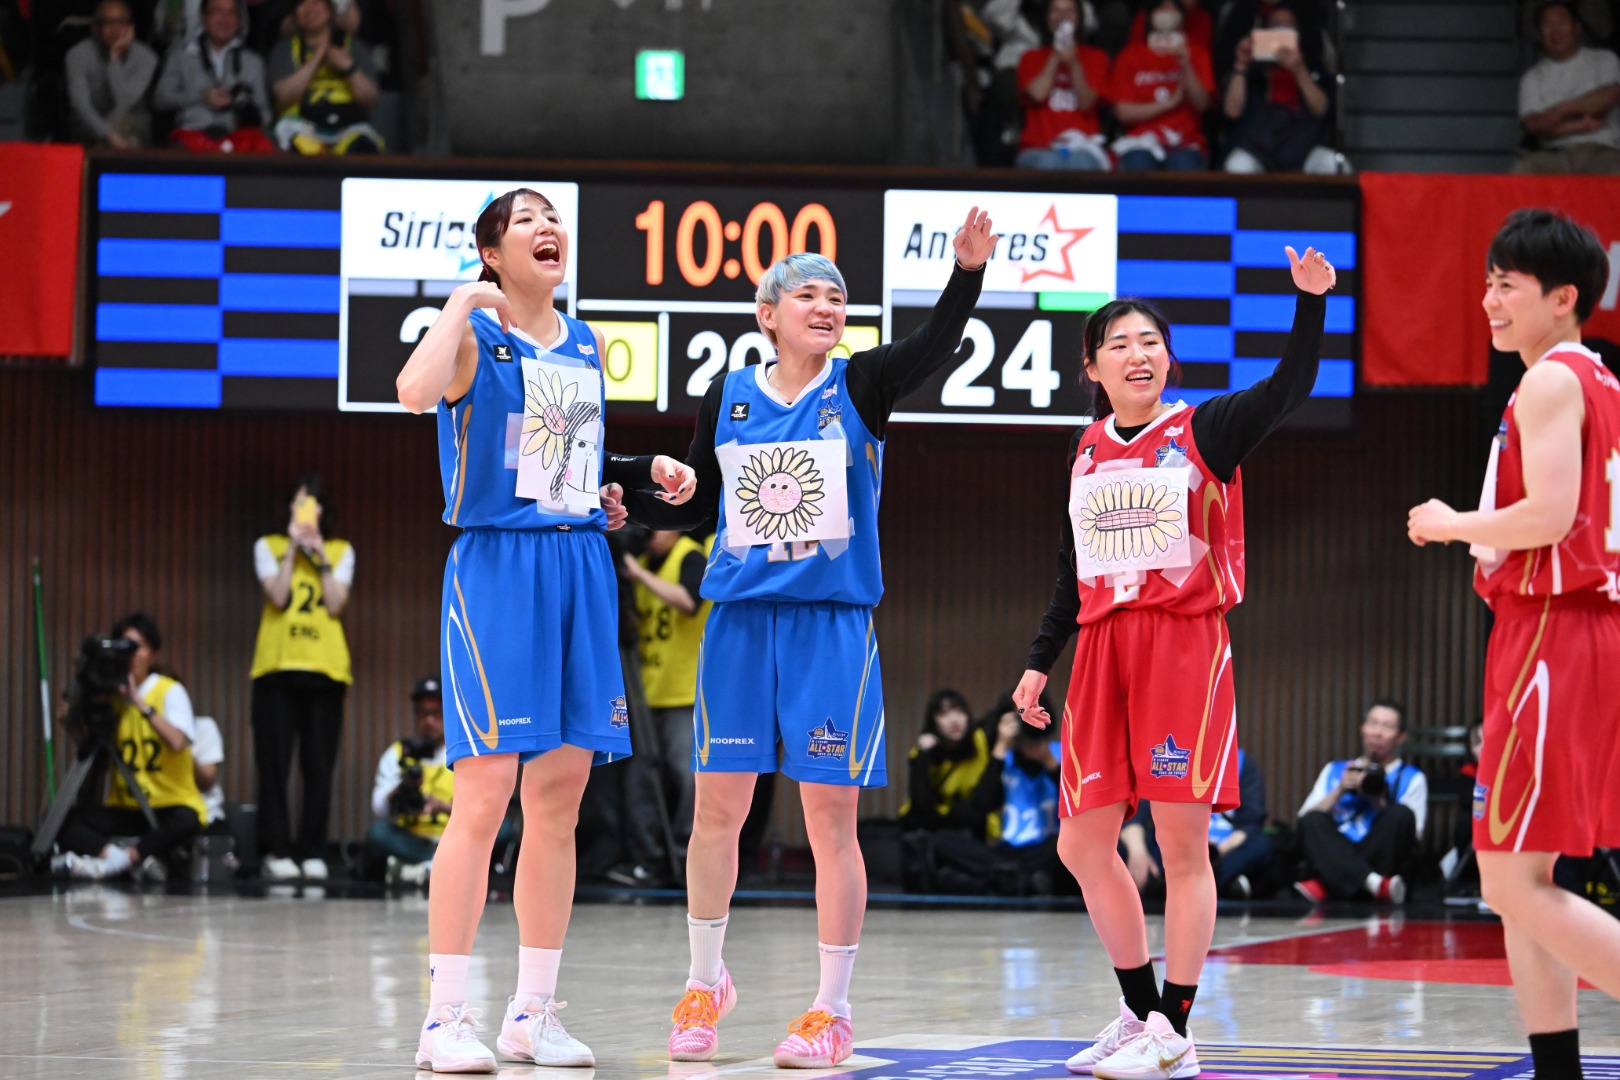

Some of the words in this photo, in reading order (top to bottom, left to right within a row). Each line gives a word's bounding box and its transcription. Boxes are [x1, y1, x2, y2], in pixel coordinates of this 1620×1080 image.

[635, 200, 837, 287] 10:00
[904, 223, 1049, 262] Anres
[941, 317, 1060, 408] 24
[710, 737, 754, 745] HOOPREX
